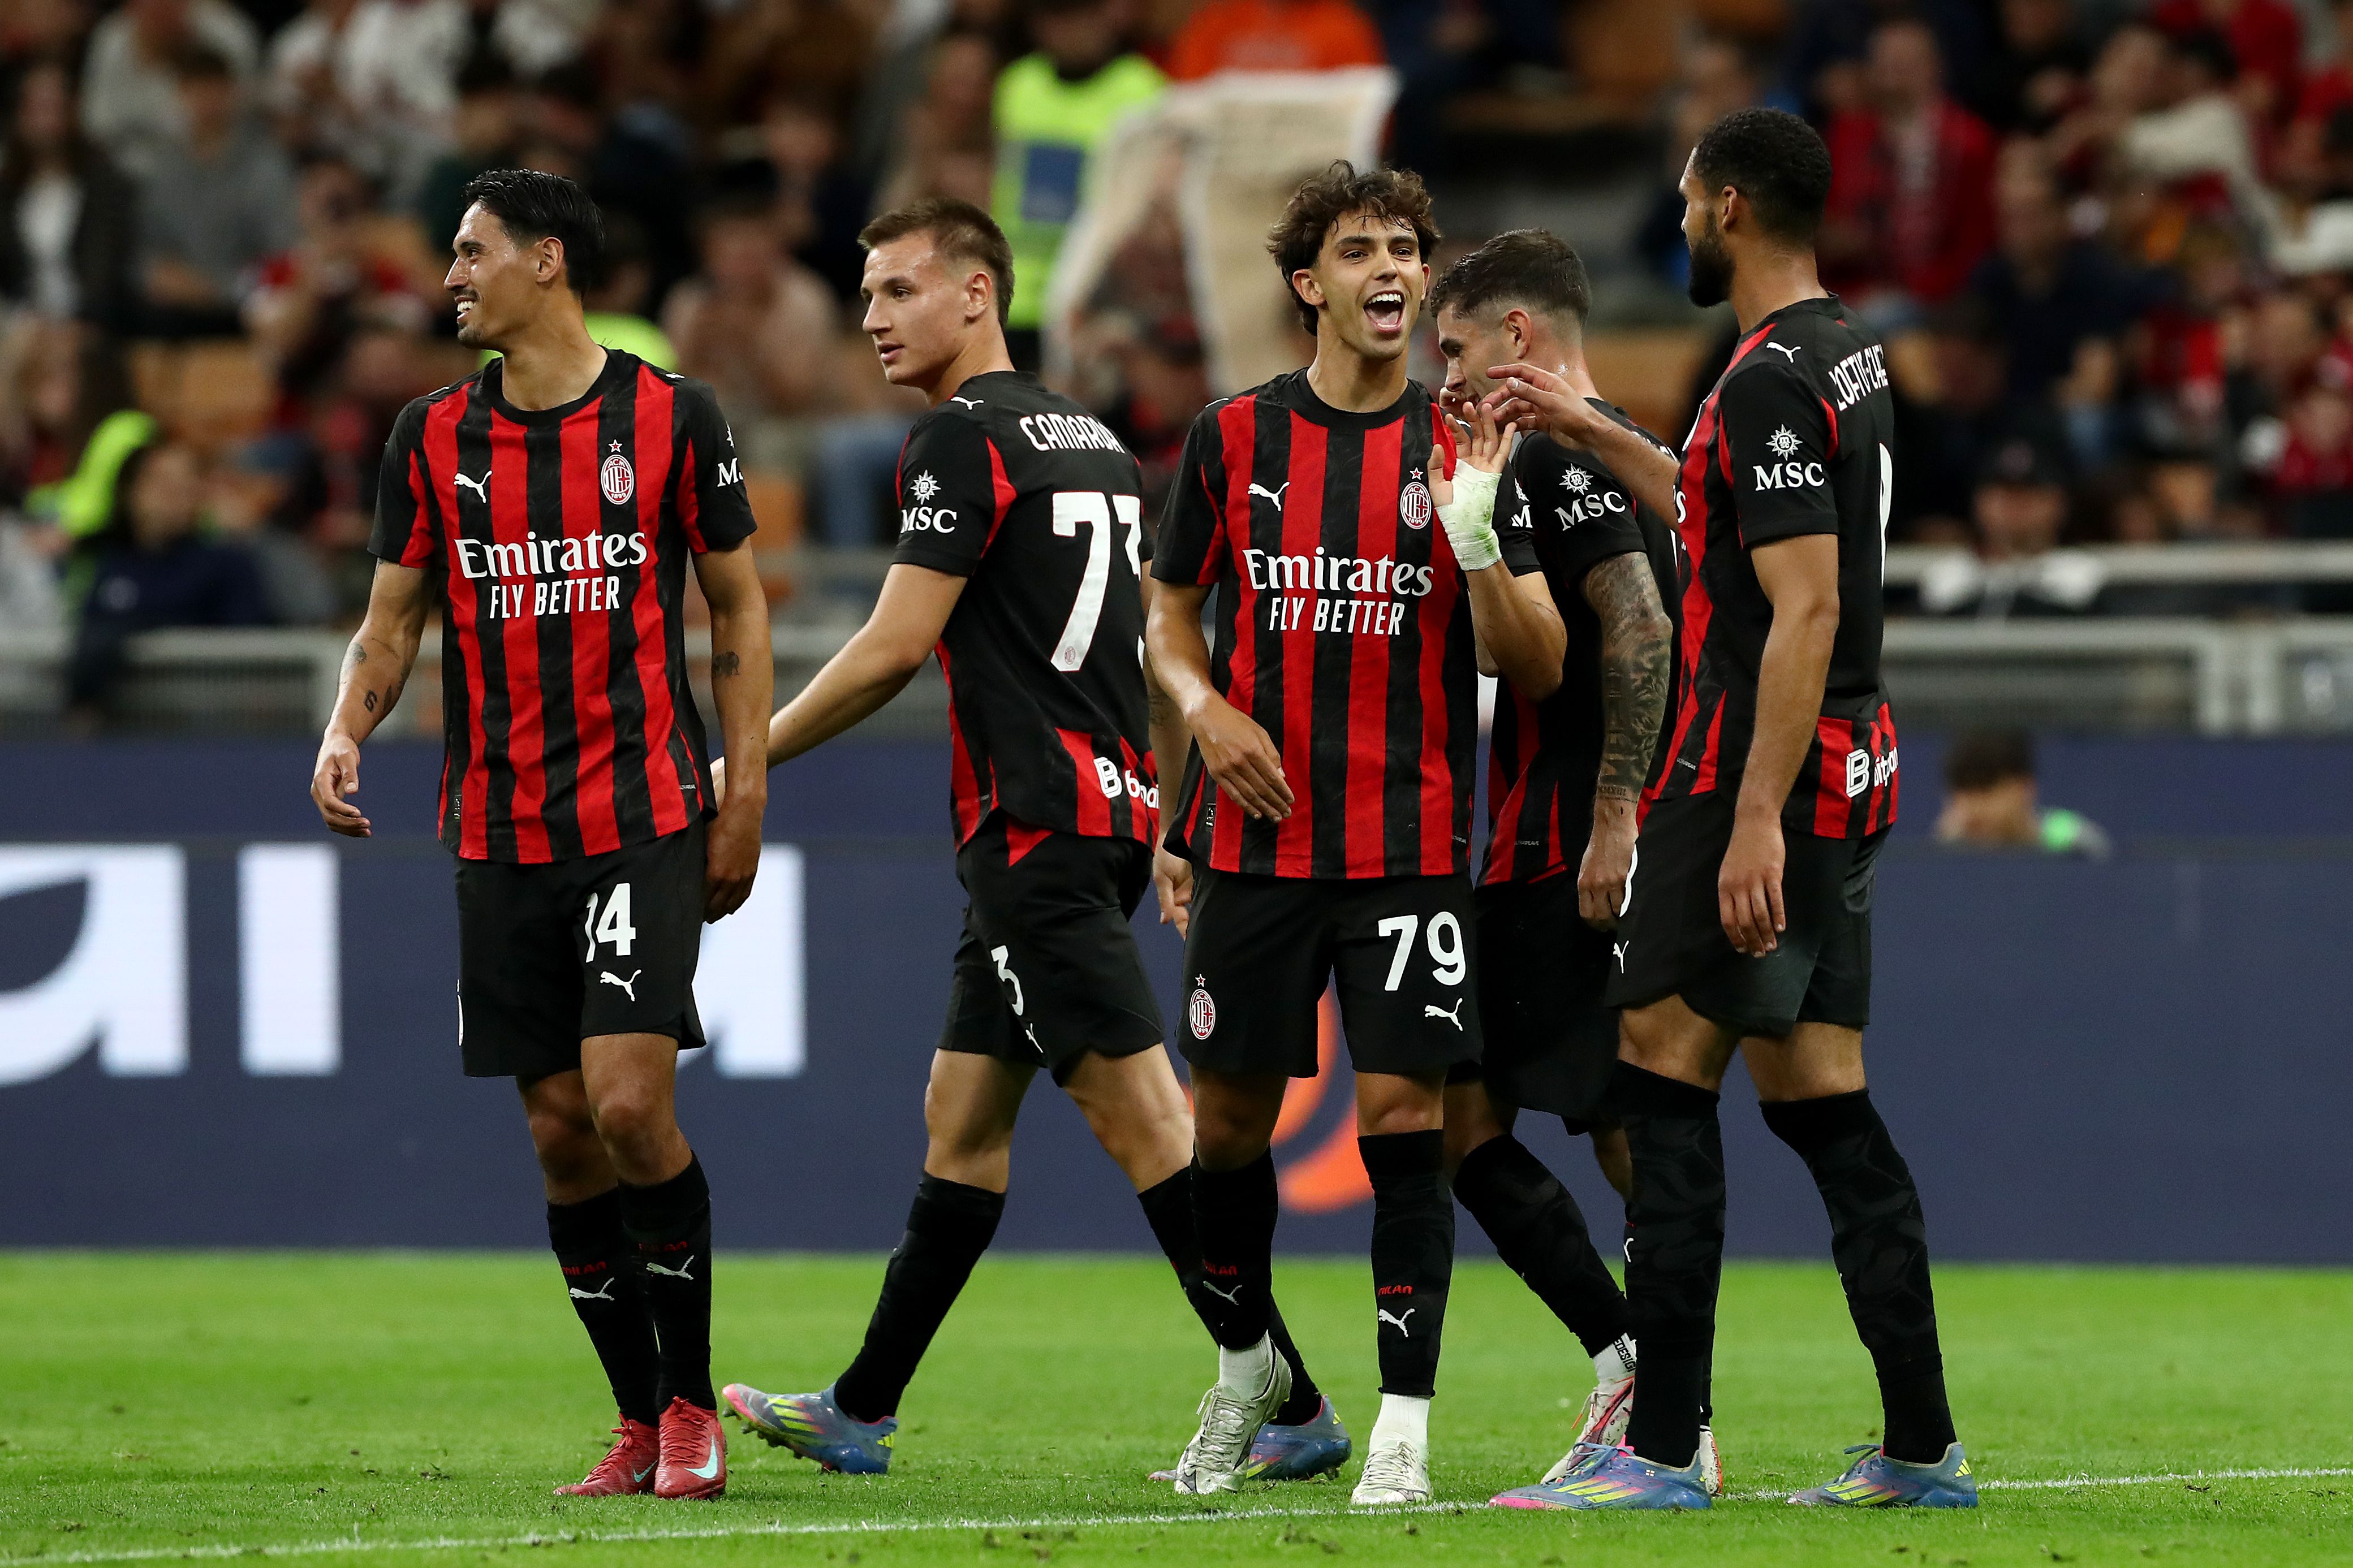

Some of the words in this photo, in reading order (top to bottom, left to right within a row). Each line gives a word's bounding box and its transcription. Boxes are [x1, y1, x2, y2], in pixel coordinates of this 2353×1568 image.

[1019, 413, 1126, 454] CAMARDA
[607, 459, 626, 468] ACM
[1752, 462, 1825, 491] MSC
[1407, 486, 1425, 496] ACM
[1554, 491, 1626, 531] MSC
[900, 507, 957, 533] MSC
[454, 529, 647, 578] Emirates
[1242, 546, 1433, 596] Emirates
[490, 584, 524, 619] FLY
[534, 576, 620, 616] BETTER
[1269, 597, 1305, 631] FLY
[1312, 598, 1405, 636] BETTER
[584, 883, 636, 963] 14
[1378, 911, 1466, 991] 79
